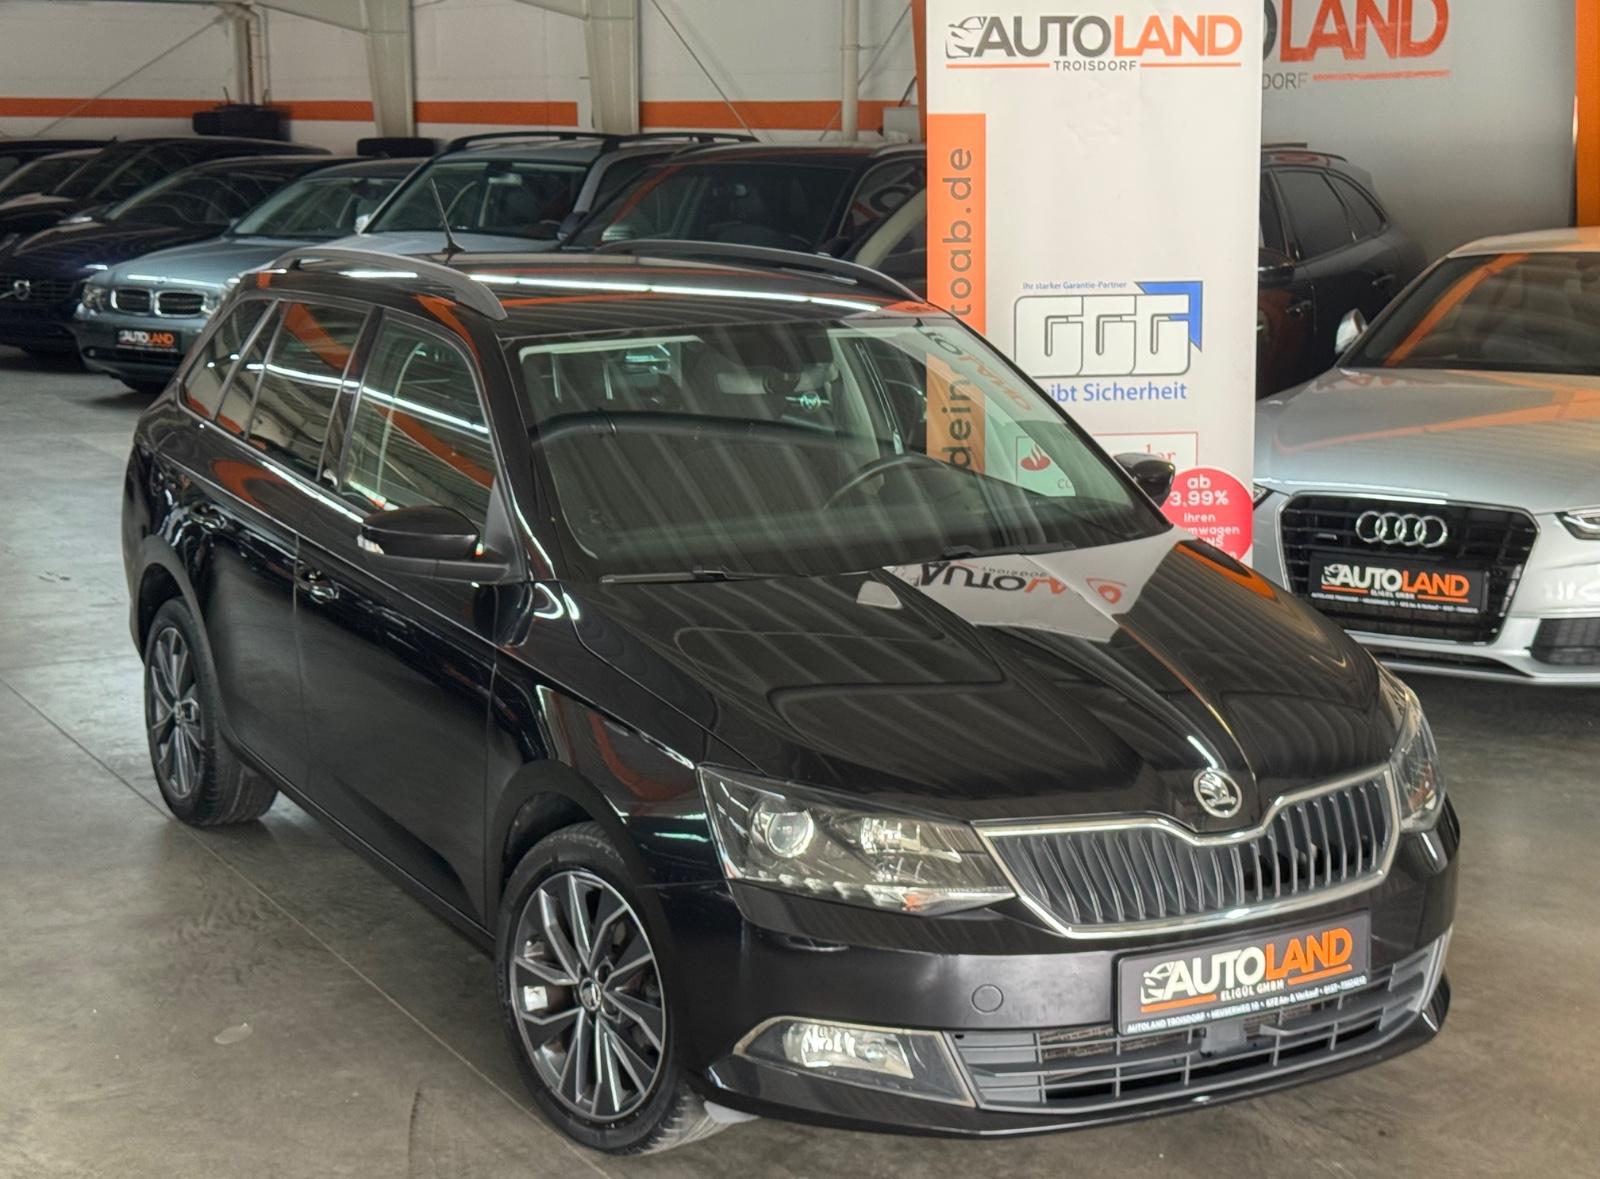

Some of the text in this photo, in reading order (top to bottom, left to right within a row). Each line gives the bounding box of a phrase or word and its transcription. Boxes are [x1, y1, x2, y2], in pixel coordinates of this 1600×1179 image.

[973, 15, 1243, 58] AUTOLAND
[1263, 0, 1449, 62] LAND
[1054, 60, 1137, 72] TROISDORF
[1023, 281, 1127, 290] Ihr starker Garantie-Partner
[1047, 381, 1187, 402] ibt Sicherheit
[1187, 474, 1211, 489] ab
[1184, 512, 1216, 523] Ihren
[1337, 565, 1470, 597] AUTOLAND
[1163, 927, 1353, 1001] AUTOLAND
